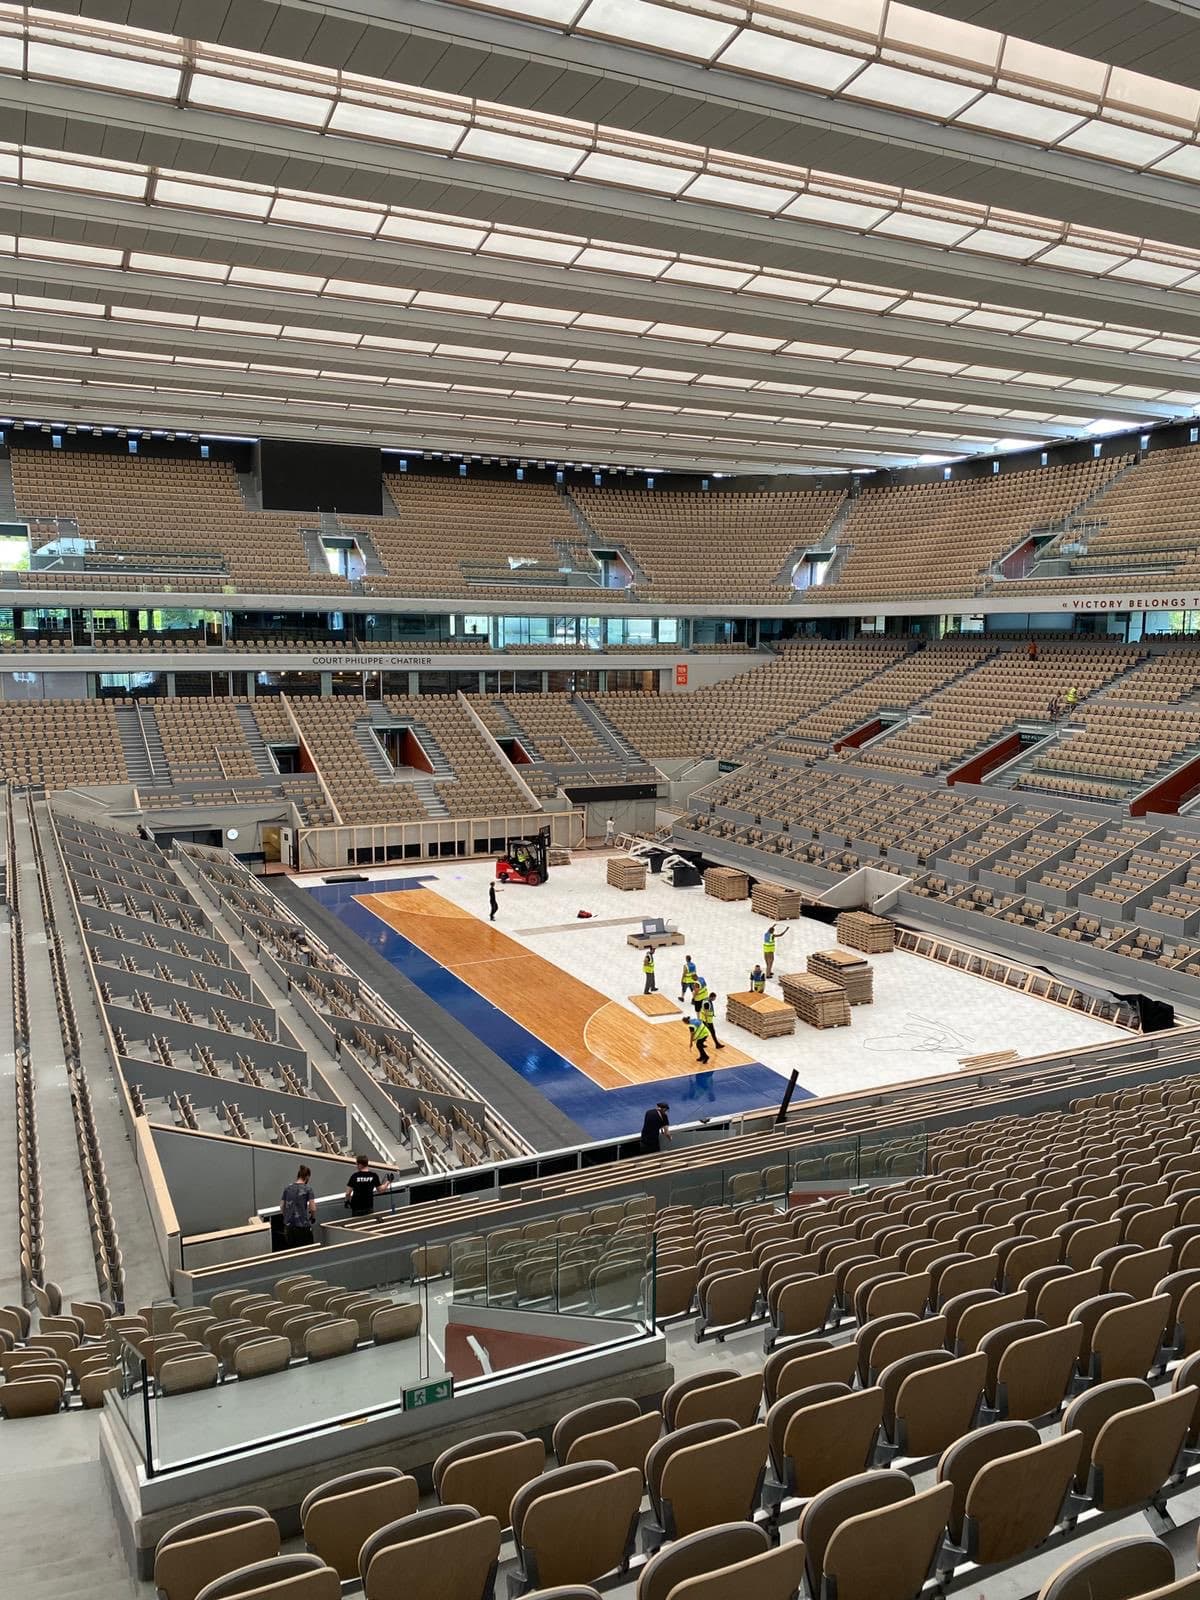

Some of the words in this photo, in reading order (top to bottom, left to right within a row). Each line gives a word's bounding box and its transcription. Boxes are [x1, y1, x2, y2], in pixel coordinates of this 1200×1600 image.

[1073, 600, 1123, 609] VICTORY
[1129, 598, 1186, 608] BELONGS
[312, 656, 342, 665] COURT
[345, 656, 383, 665] PHILIPPE
[390, 656, 432, 665] CHATRIER
